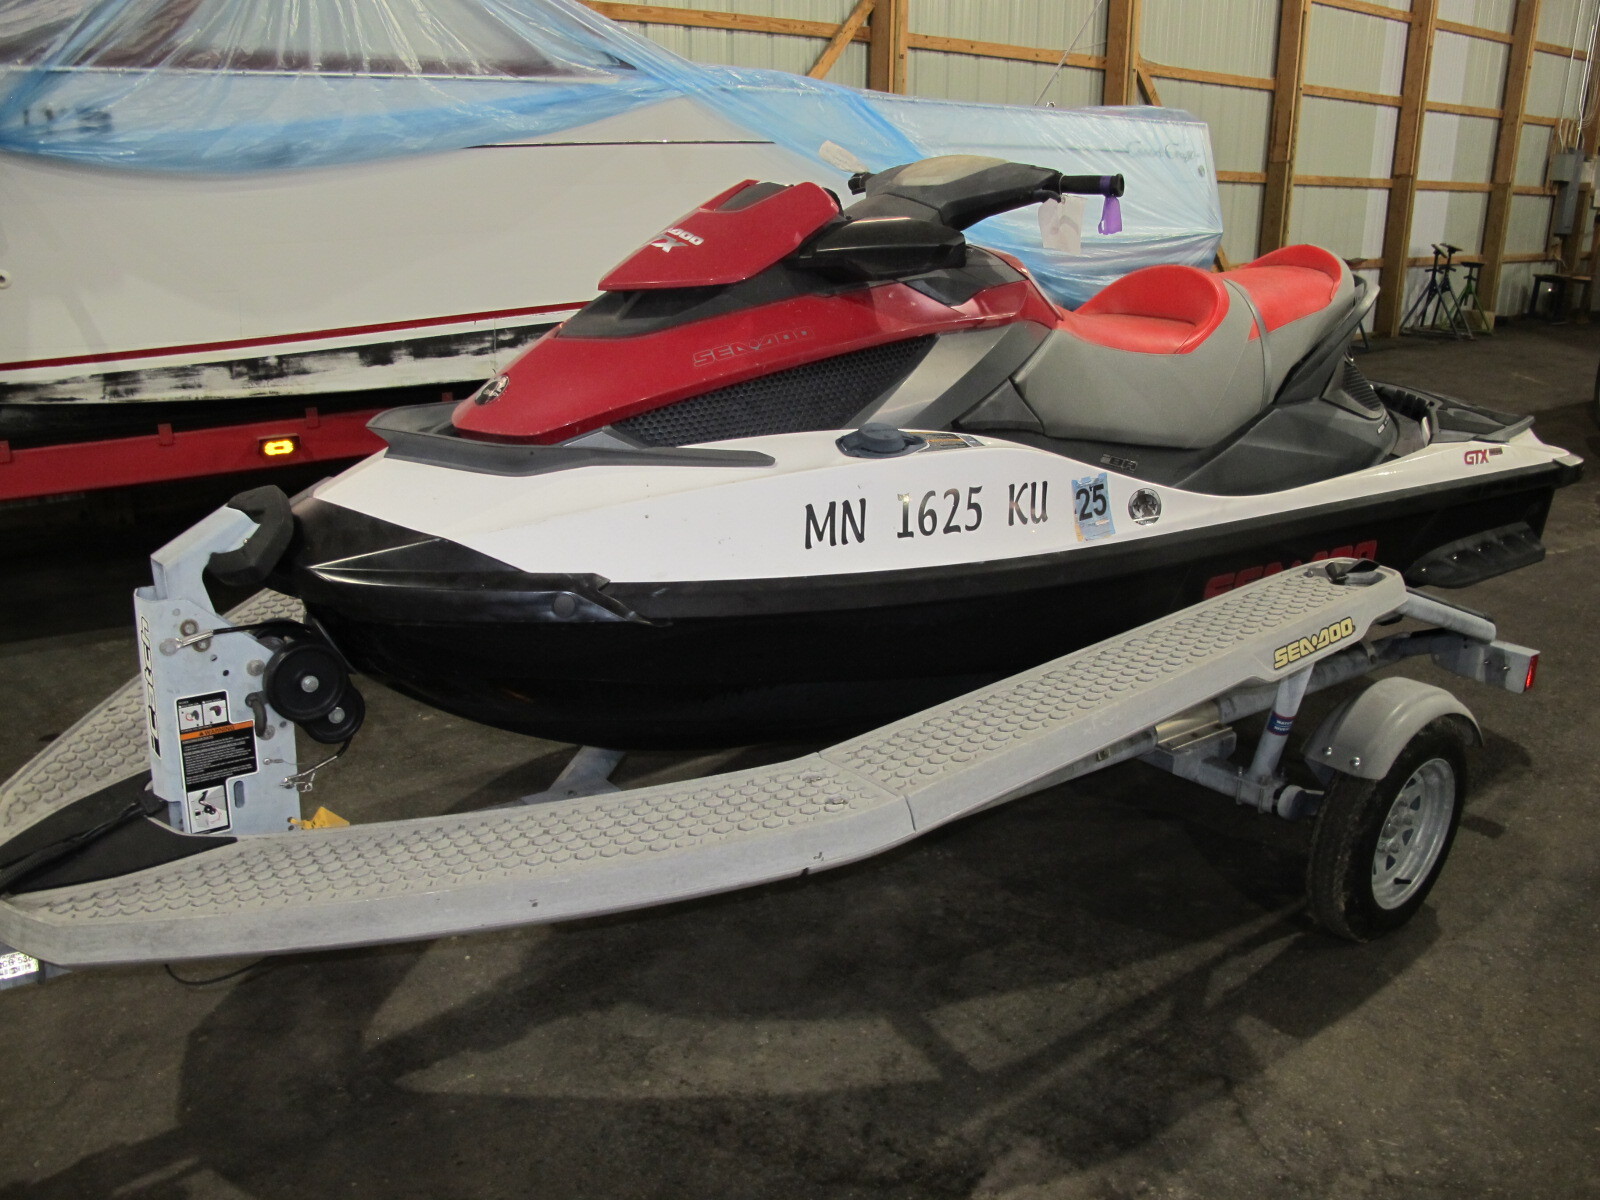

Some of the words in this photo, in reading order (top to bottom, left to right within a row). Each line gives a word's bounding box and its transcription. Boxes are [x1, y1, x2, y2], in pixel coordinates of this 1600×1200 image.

[1463, 448, 1489, 465] GTX
[805, 498, 867, 550] MN
[896, 485, 983, 539] 1625
[1007, 480, 1049, 527] KU
[1075, 483, 1107, 521] 25
[204, 725, 235, 737] WARNING
